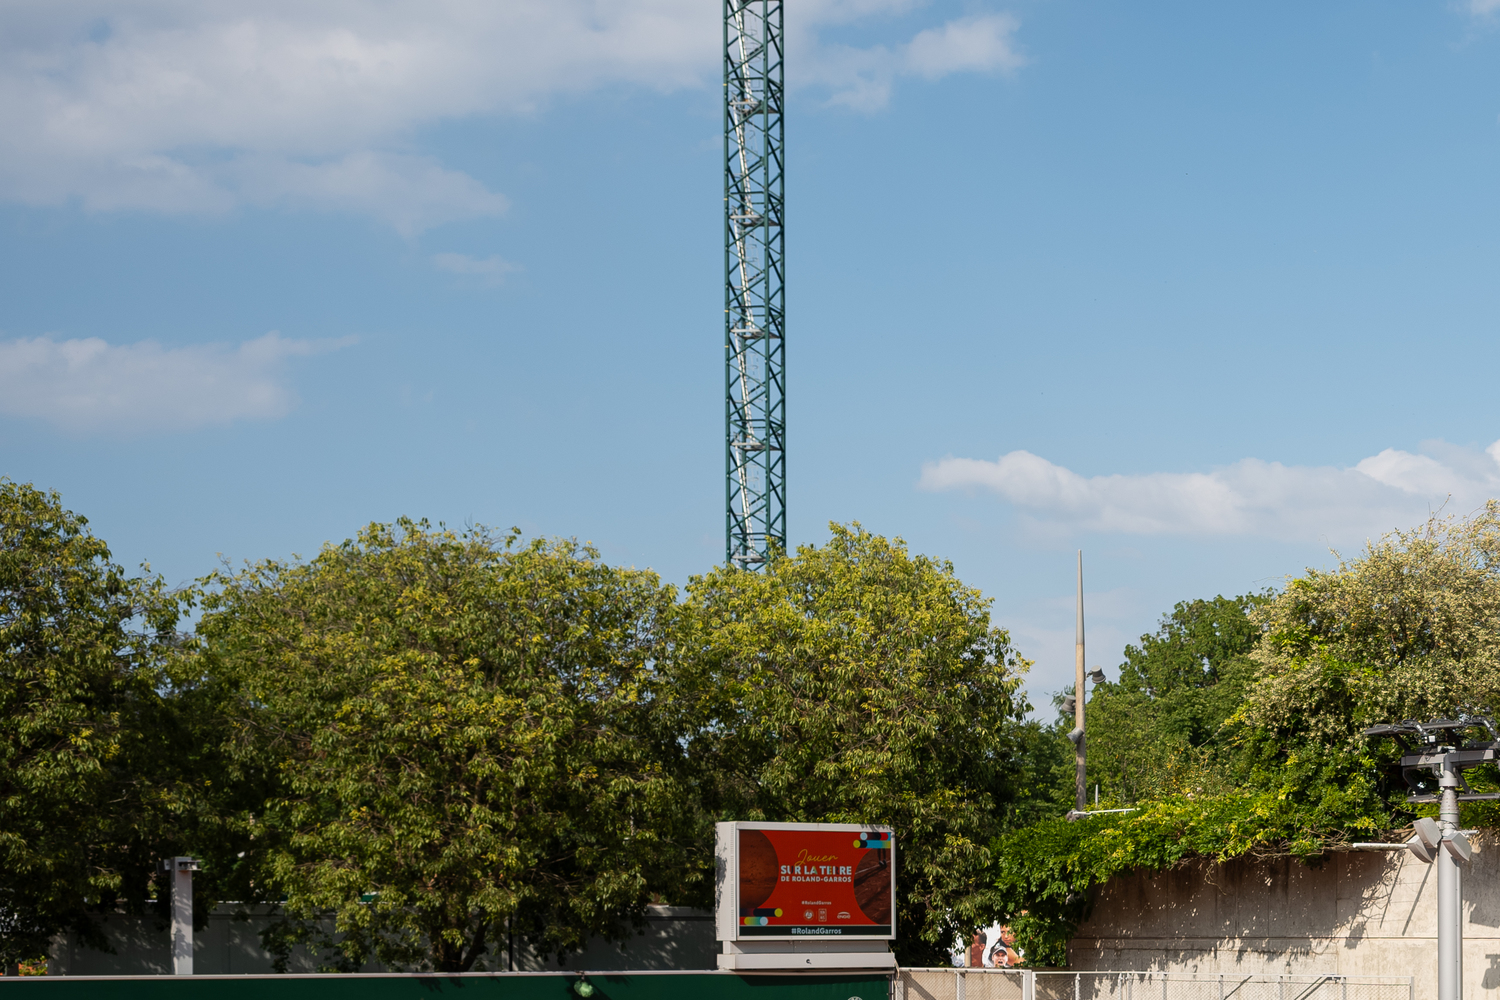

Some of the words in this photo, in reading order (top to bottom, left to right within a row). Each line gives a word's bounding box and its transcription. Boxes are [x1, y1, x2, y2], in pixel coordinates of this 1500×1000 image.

[794, 849, 838, 866] Jouer
[781, 865, 801, 875] SUR
[804, 866, 818, 875] LA
[819, 866, 852, 875] TERRE
